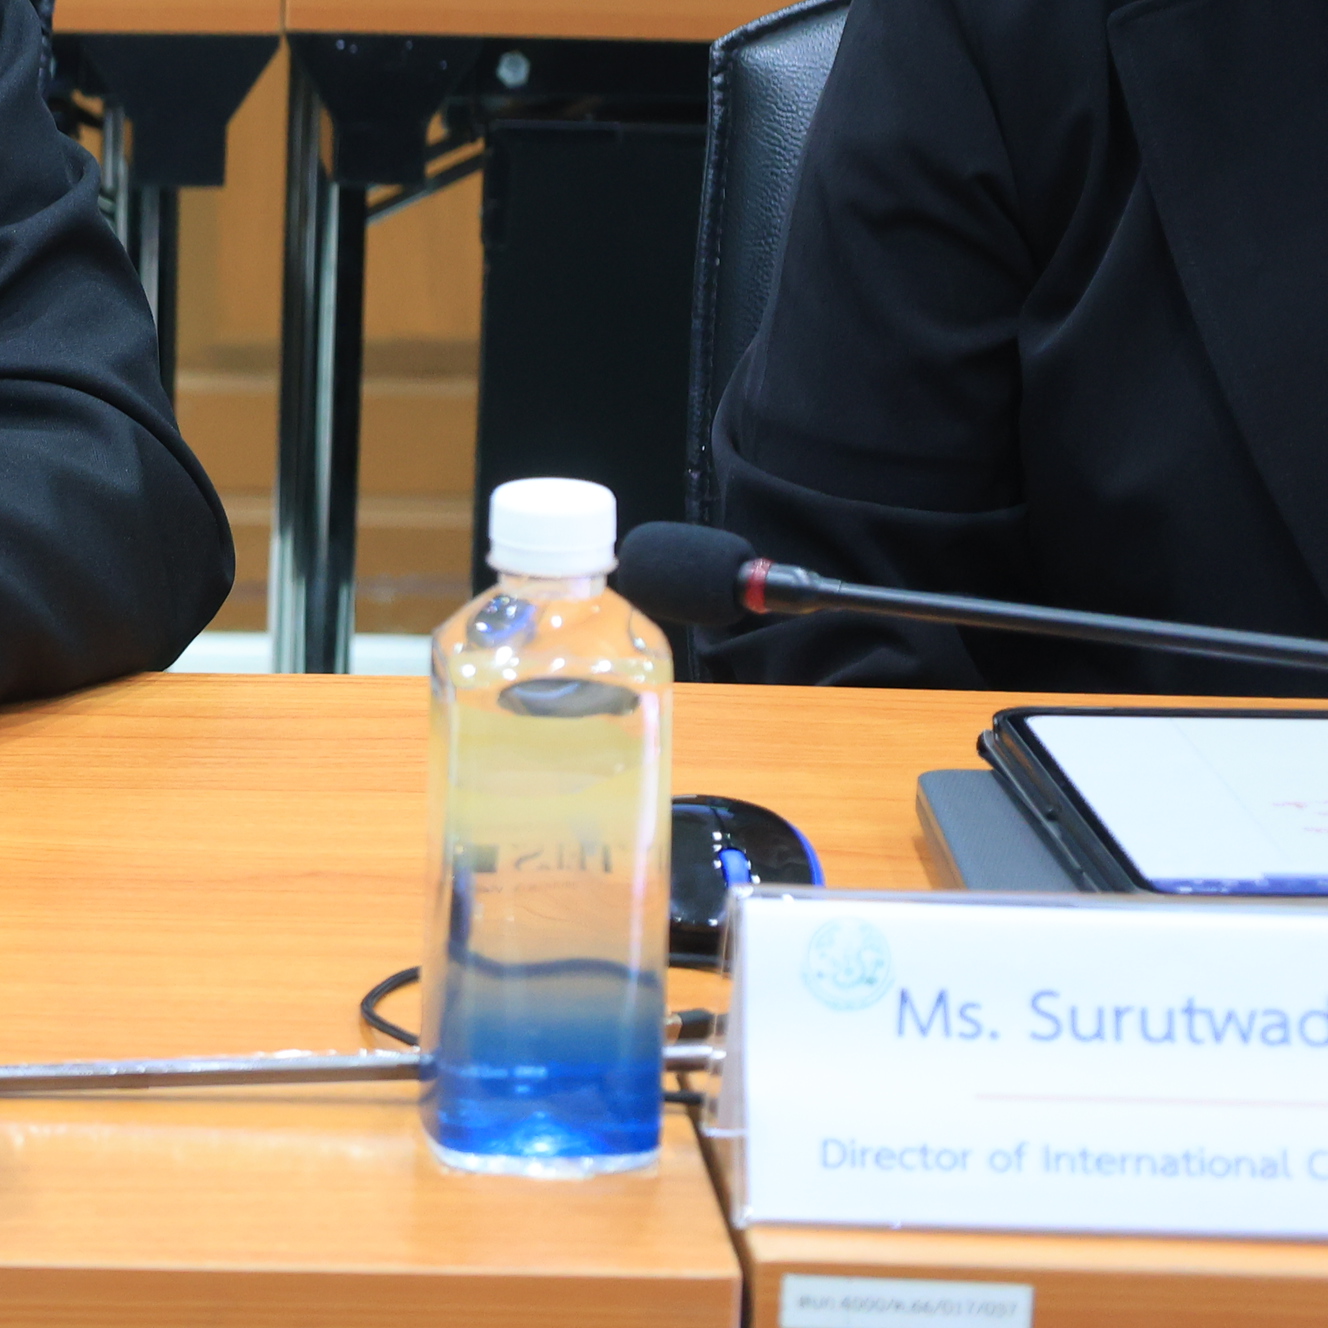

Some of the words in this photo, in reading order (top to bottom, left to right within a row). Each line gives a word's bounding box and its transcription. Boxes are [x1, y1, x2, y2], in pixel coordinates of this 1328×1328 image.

[895, 987, 1000, 1041] Ms.
[818, 1136, 974, 1174] Director
[987, 1140, 1030, 1175] of
[1041, 1143, 1294, 1182] International
